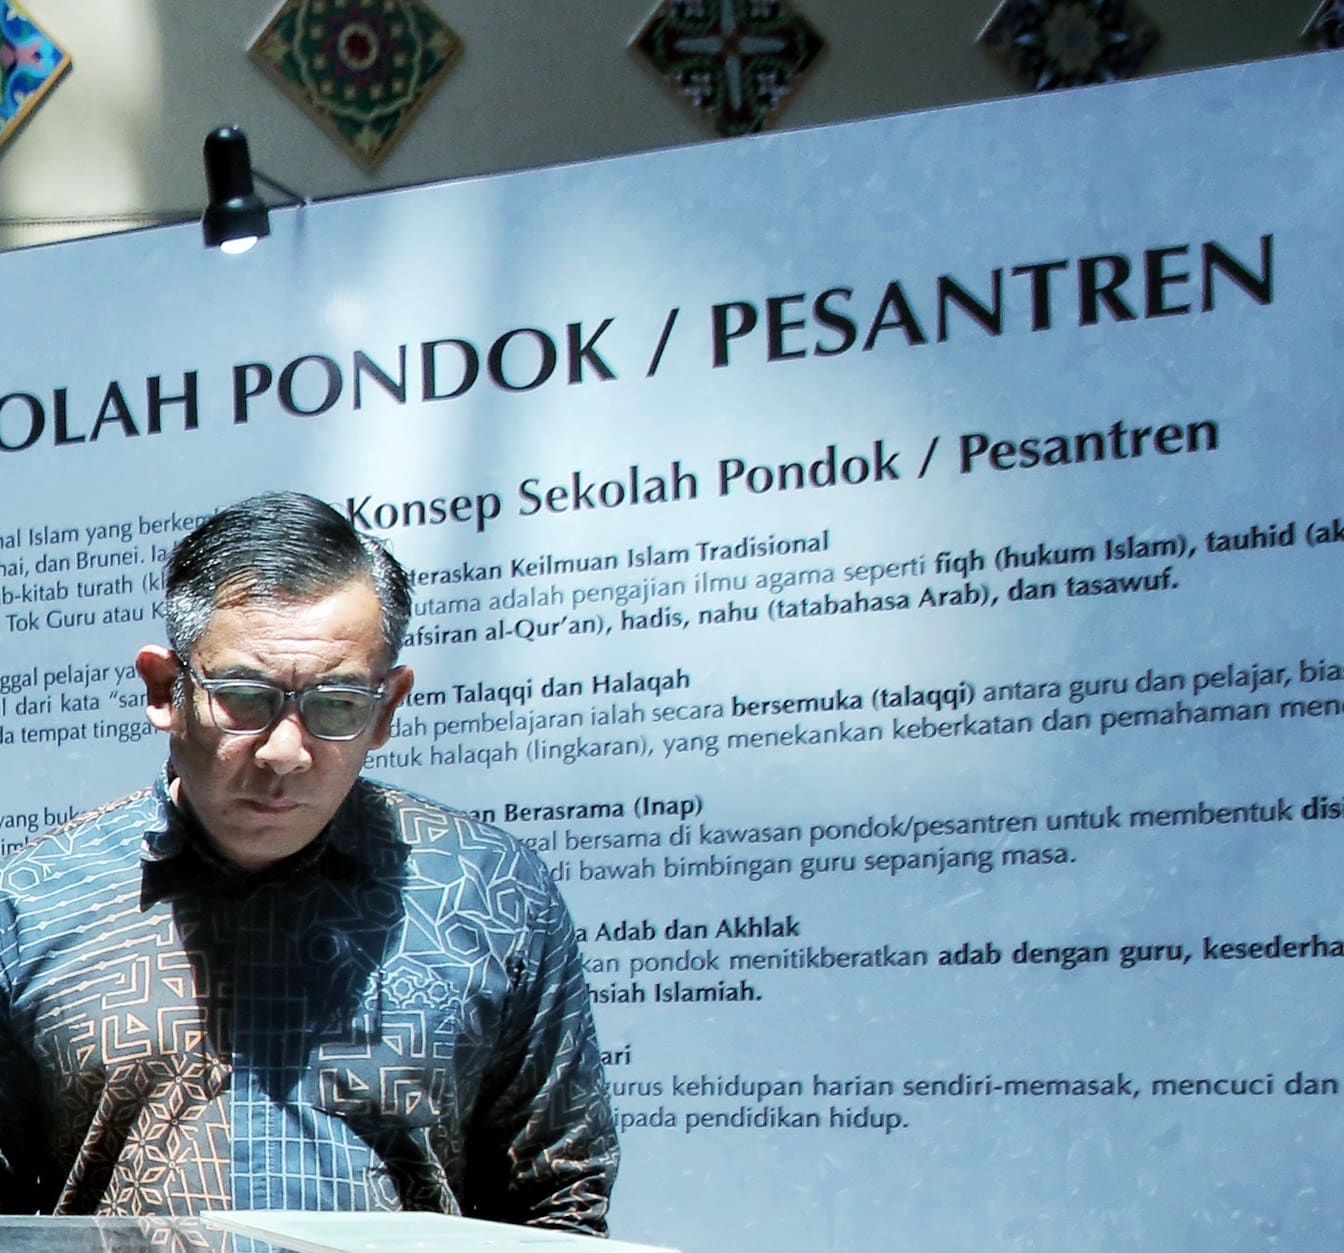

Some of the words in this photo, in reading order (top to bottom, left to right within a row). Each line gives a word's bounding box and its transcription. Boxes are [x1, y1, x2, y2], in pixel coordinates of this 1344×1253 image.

[232, 318, 618, 425] PONDOK
[645, 307, 680, 378] /
[711, 233, 1274, 369] PESANTREN
[349, 492, 502, 534] Konsep
[518, 461, 698, 516] Sekolah
[718, 440, 901, 497] Pondok
[917, 436, 940, 479] /
[959, 420, 1219, 475] Pesantren
[30, 524, 79, 546] Islam
[77, 545, 144, 569] Brunei.
[489, 582, 563, 609] adalah
[573, 578, 685, 609] pengajian
[756, 567, 834, 593] agama
[844, 556, 924, 586] seperti
[995, 544, 1095, 575] (hukum
[1106, 532, 1196, 560] Islam),
[1206, 524, 1296, 552] tauhid
[512, 553, 617, 577] Keilmuan
[629, 545, 688, 568] Islam
[696, 529, 828, 562] Tradisional
[78, 571, 132, 597] turath
[622, 606, 689, 631] hadis,
[769, 590, 909, 625] (tatabahasa
[919, 581, 998, 609] Arab),
[1066, 567, 1178, 596] tasawuf.
[44, 662, 109, 690] pelajar
[453, 680, 531, 707] Talaqqi
[593, 666, 689, 696] Halaqah
[434, 708, 583, 741] pembelajaran
[592, 701, 644, 725] ialah
[653, 702, 723, 721] secara
[732, 688, 862, 716] bersemuka
[873, 681, 975, 714] (talaqqi)
[984, 680, 1061, 701] antara
[1194, 665, 1291, 695] pelajar,
[22, 721, 86, 746] tempat
[431, 739, 517, 769] halaqah
[527, 732, 653, 766] (lingkaran),
[728, 720, 882, 748] menekankan
[893, 714, 1032, 739] keberkatan
[1101, 702, 1270, 734] pemahaman
[505, 800, 624, 822] Berasrama
[635, 792, 702, 822] (Inap)
[566, 828, 660, 849] bersama
[700, 822, 801, 844] kawasan
[810, 814, 1037, 846] pondok/pesantren
[1047, 806, 1120, 830] untuk
[1130, 799, 1292, 827] membentuk
[580, 856, 655, 880] bawah
[665, 854, 791, 881] bimbingan
[865, 849, 994, 876] sepanjang
[1002, 848, 1076, 865] masa.
[716, 915, 799, 938] Akhlak
[631, 949, 719, 978] pondok
[730, 945, 927, 969] menitikberatkan
[1012, 942, 1109, 968] dengan
[1120, 945, 1191, 967] guru,
[656, 979, 762, 1002] Islamiah.
[673, 1075, 802, 1102] kehidupan
[814, 1074, 893, 1095] harian
[904, 1074, 1139, 1099] sendiri-memasak,
[1152, 1075, 1273, 1094] mencuci
[686, 1106, 820, 1133] pendidikan
[830, 1106, 908, 1134] hidup.
